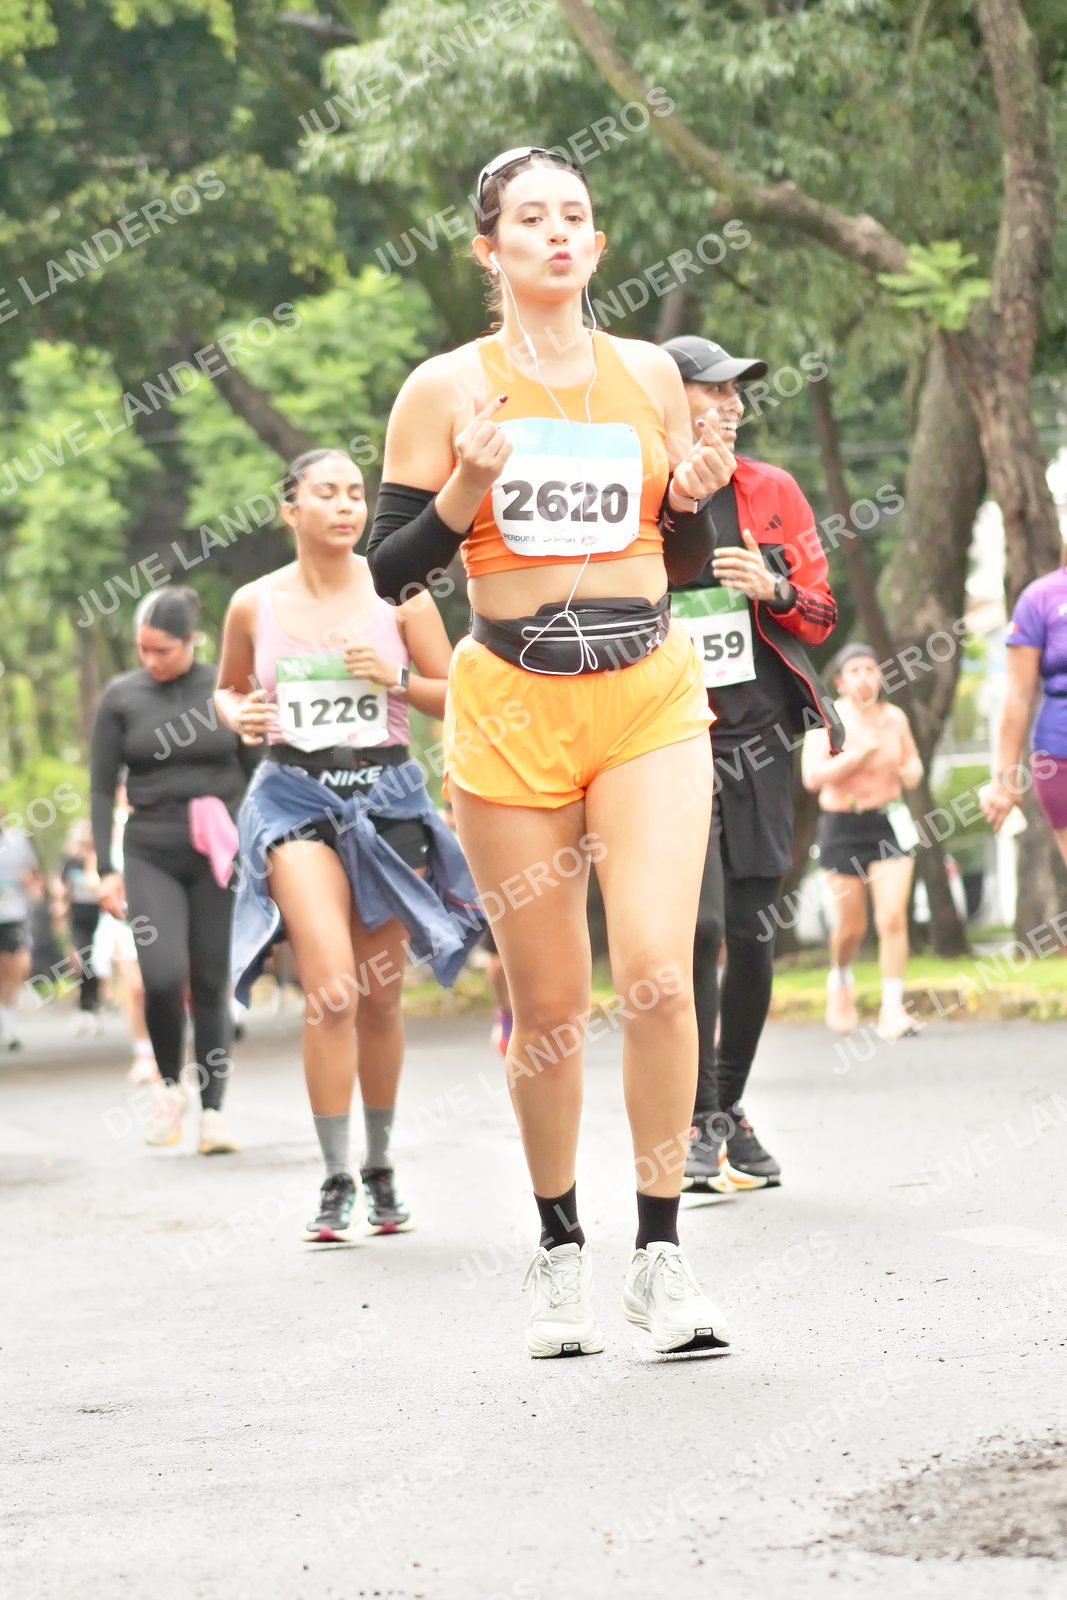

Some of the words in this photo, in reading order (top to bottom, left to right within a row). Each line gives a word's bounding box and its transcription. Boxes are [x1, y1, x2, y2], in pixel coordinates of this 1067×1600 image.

[501, 479, 629, 524] 2620
[690, 630, 745, 662] 59
[288, 694, 380, 728] 1226
[319, 765, 384, 786] NIKE
